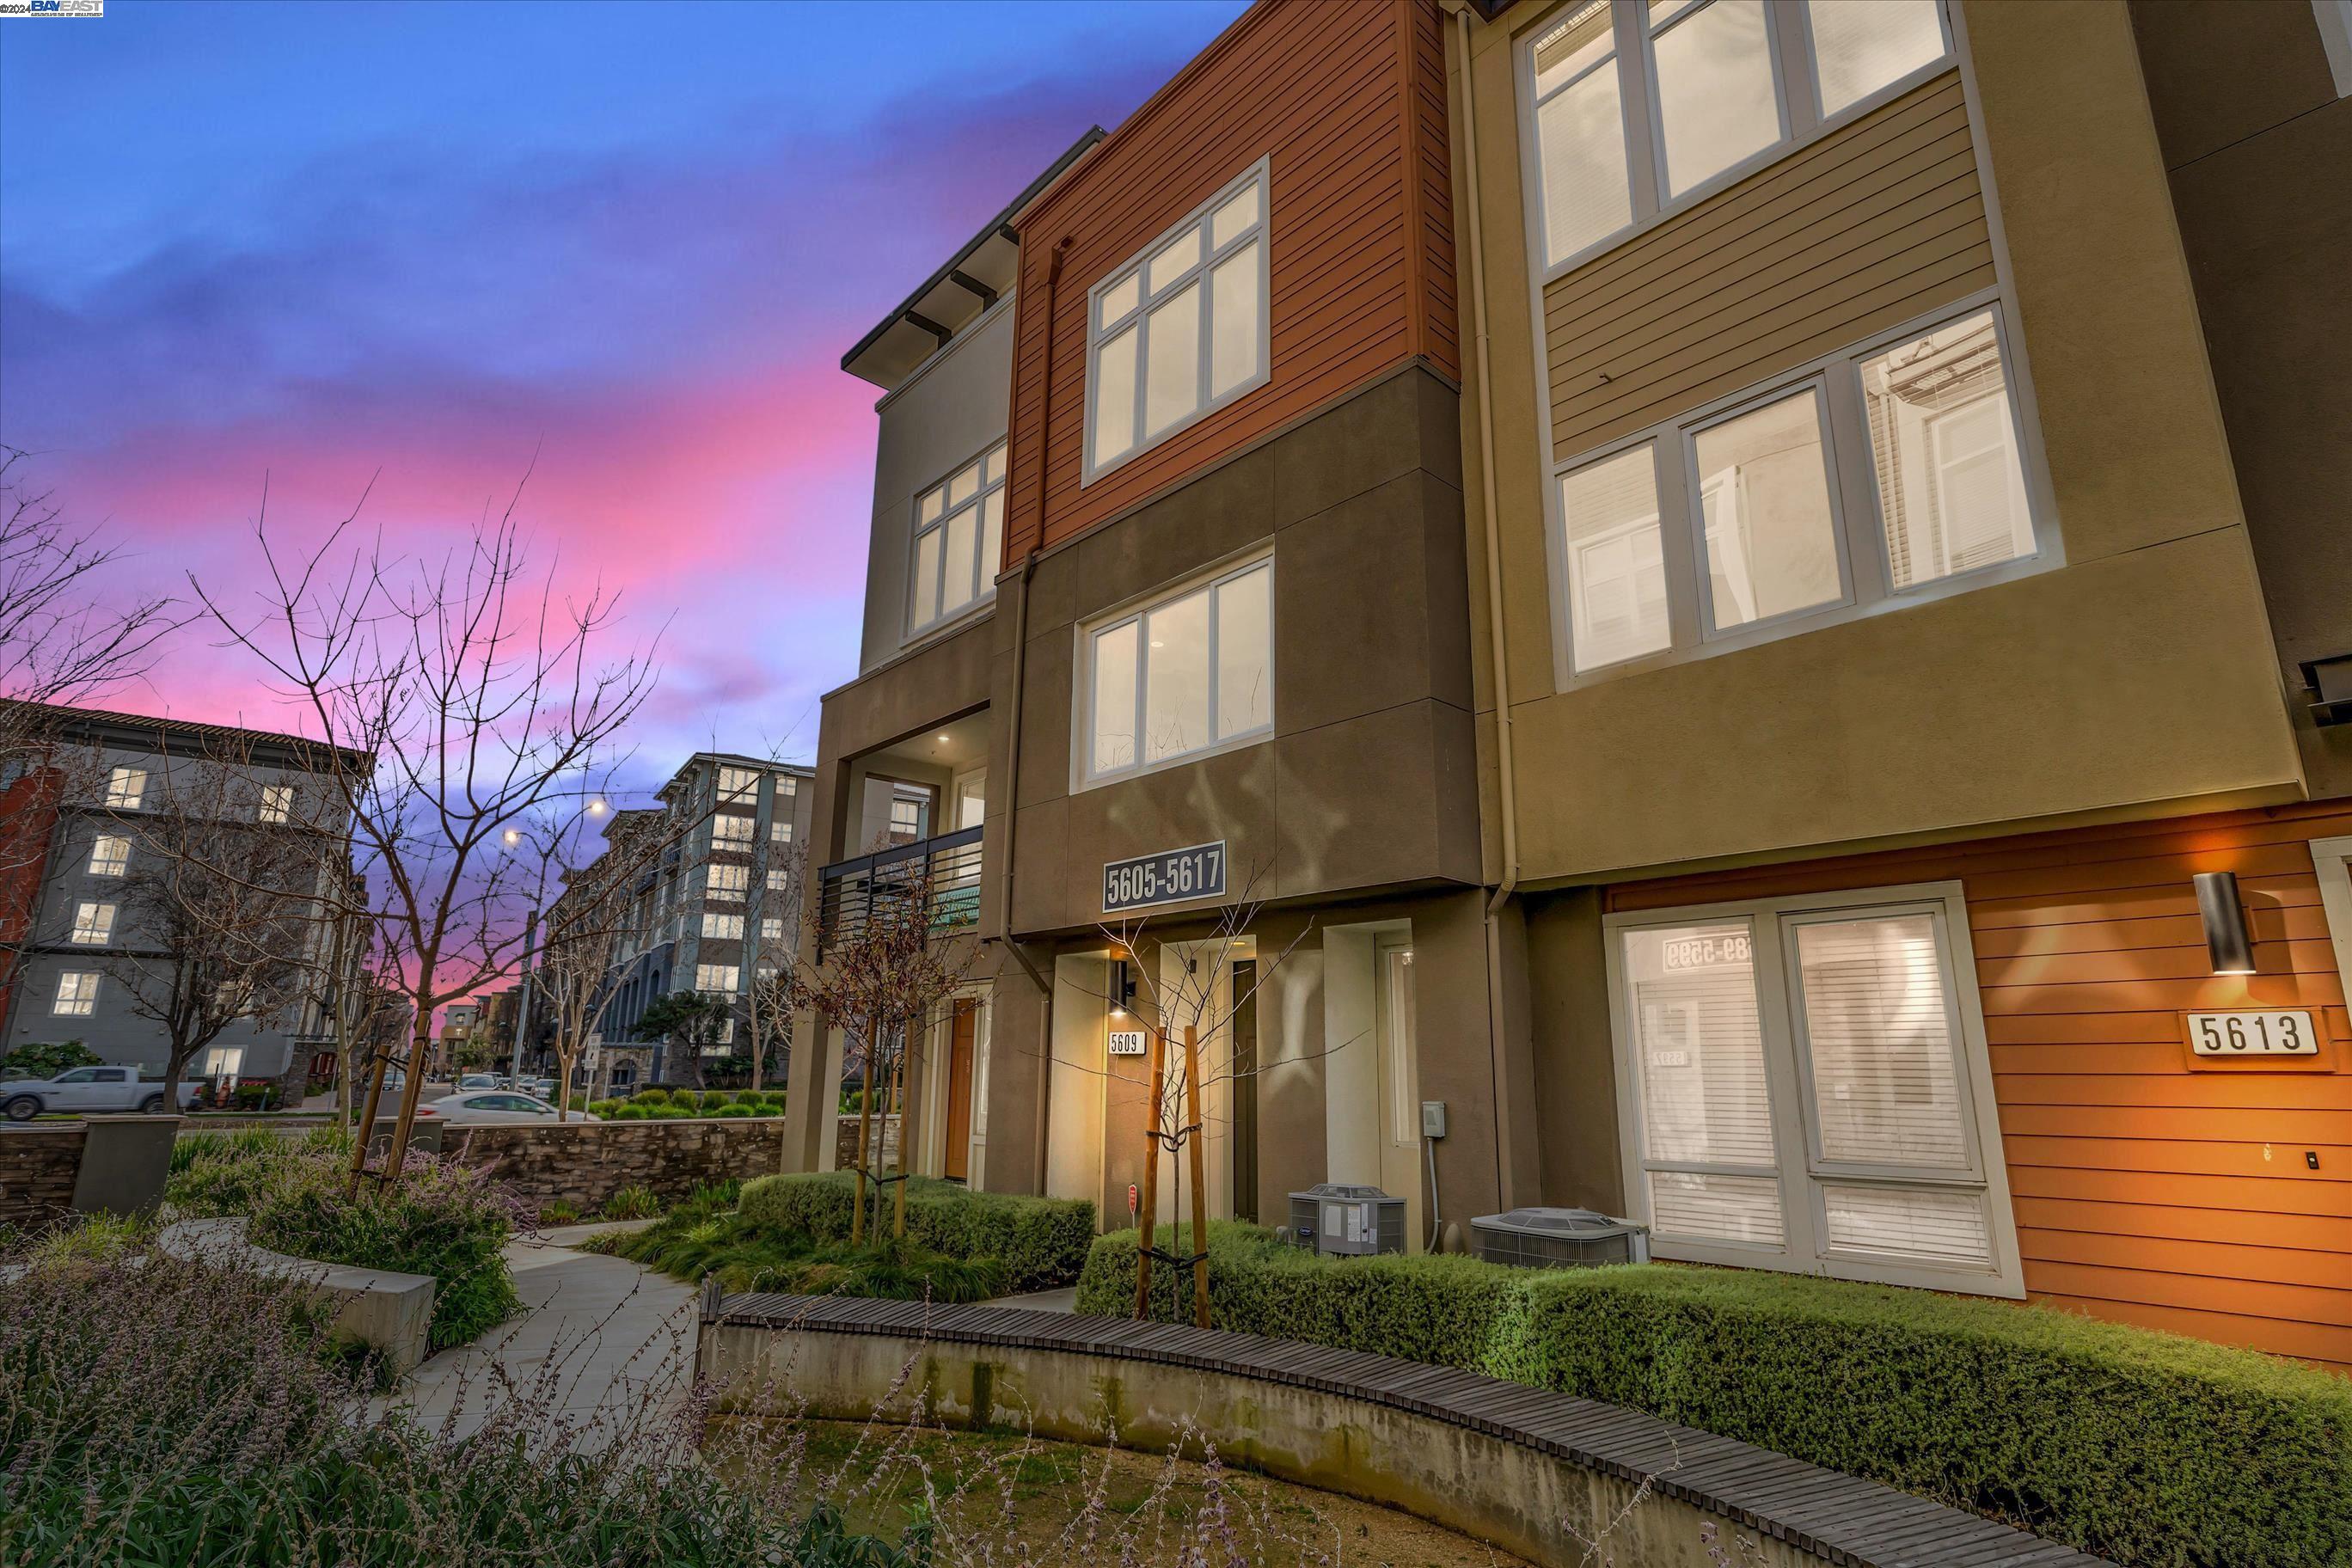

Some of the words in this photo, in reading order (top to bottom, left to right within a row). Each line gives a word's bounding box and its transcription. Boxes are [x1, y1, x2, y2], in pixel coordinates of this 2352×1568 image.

[1108, 851, 1220, 903] 5605-5617
[1112, 1034, 1136, 1051] 5609
[2201, 1016, 2300, 1050] 5613
